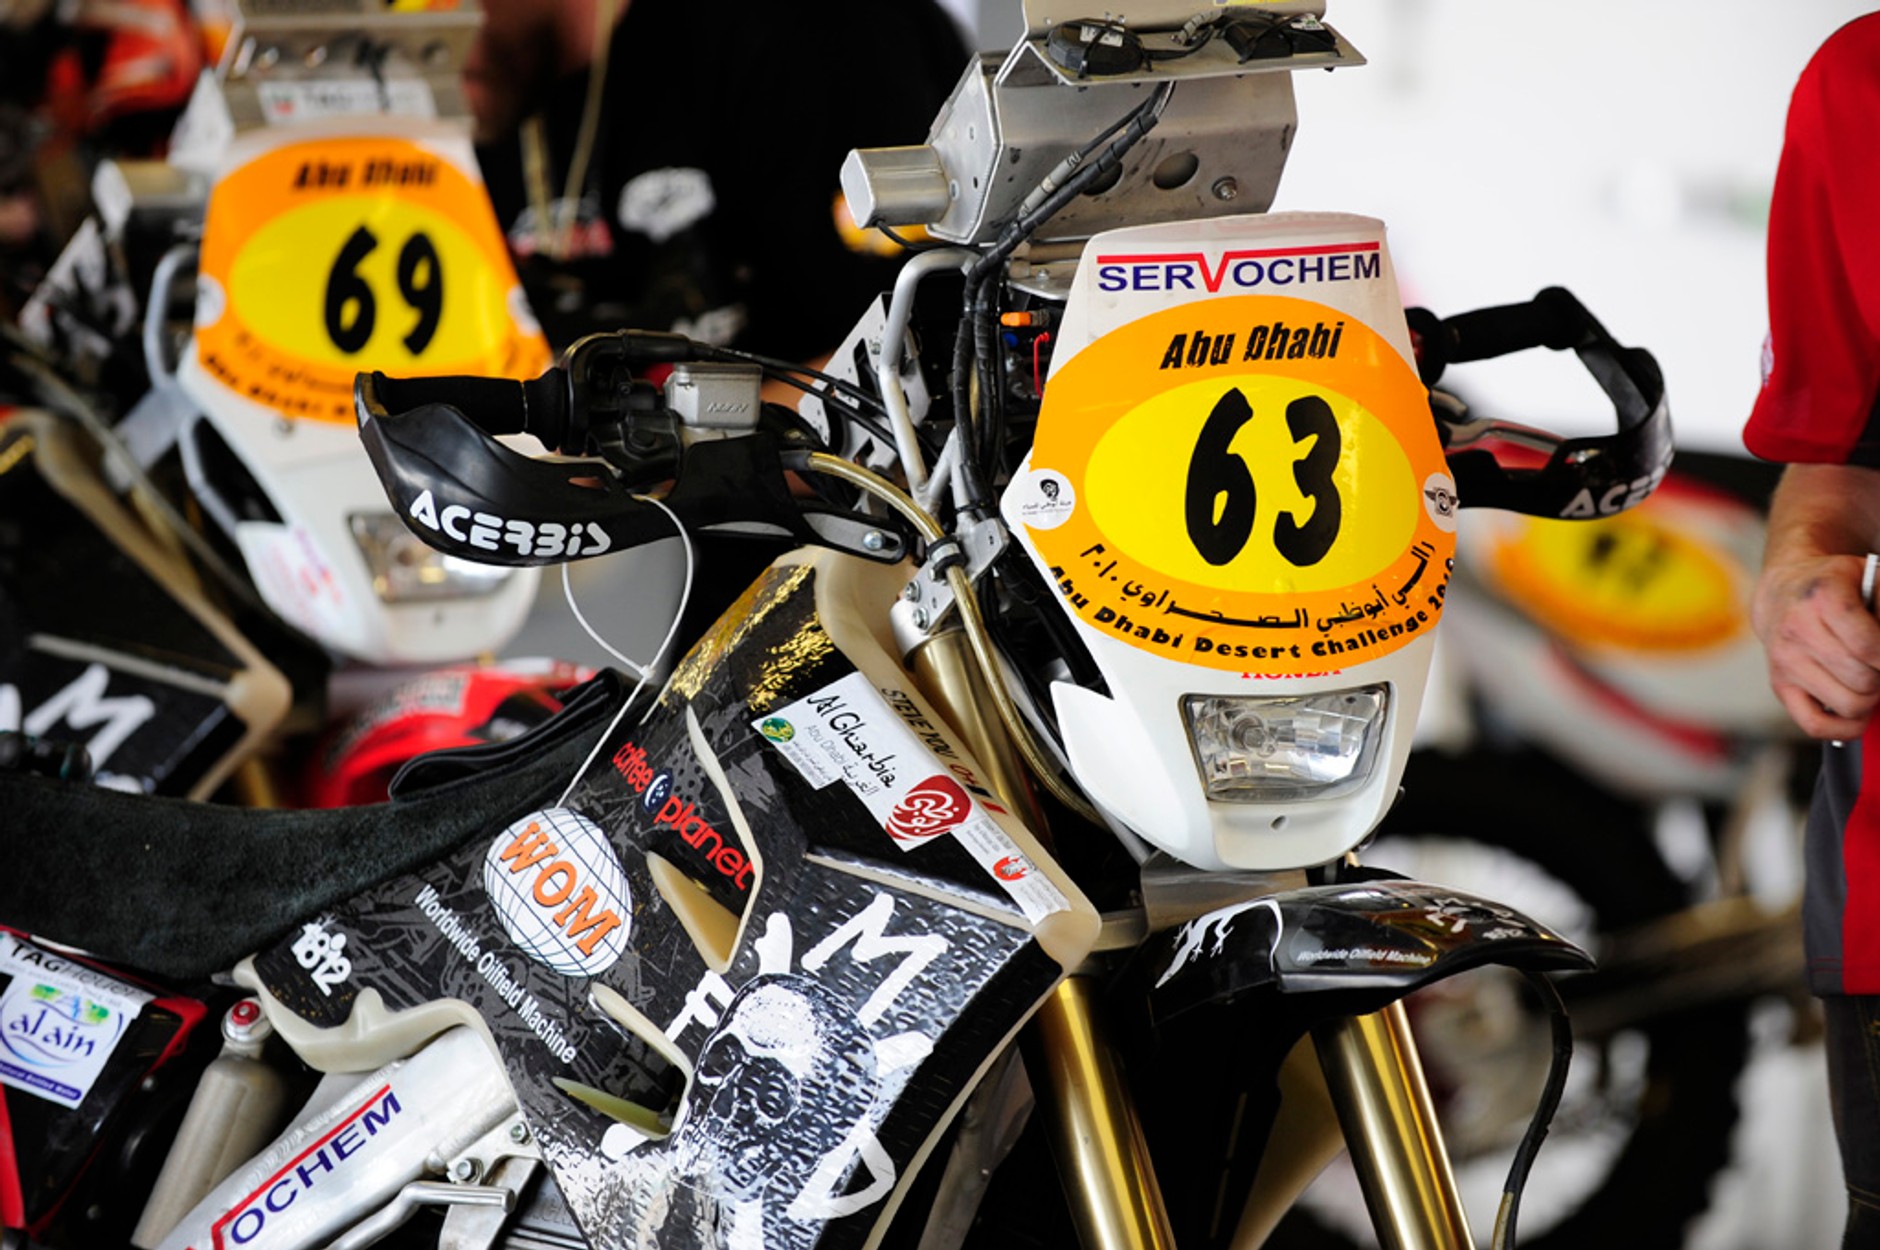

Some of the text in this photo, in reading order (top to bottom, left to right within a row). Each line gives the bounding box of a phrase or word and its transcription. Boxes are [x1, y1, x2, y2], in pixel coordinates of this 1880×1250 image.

[323, 225, 444, 356] 69
[1097, 241, 1380, 292] SERVOCHEM
[1159, 321, 1345, 370] Abu Dhabi
[410, 489, 612, 557] ACERBIS
[1185, 387, 1342, 567] 63
[1049, 565, 1090, 610] Abu
[1093, 606, 1184, 648] Dhabi
[1194, 636, 1301, 659] Desert
[1311, 610, 1429, 657] Challenge
[1391, 540, 1437, 609] رالي
[807, 695, 847, 717] Al
[829, 712, 897, 788] Gharbia
[612, 742, 756, 891] coffee planet
[500, 821, 621, 957] WOM
[415, 884, 577, 1064] Worldwide Oilfield Machine
